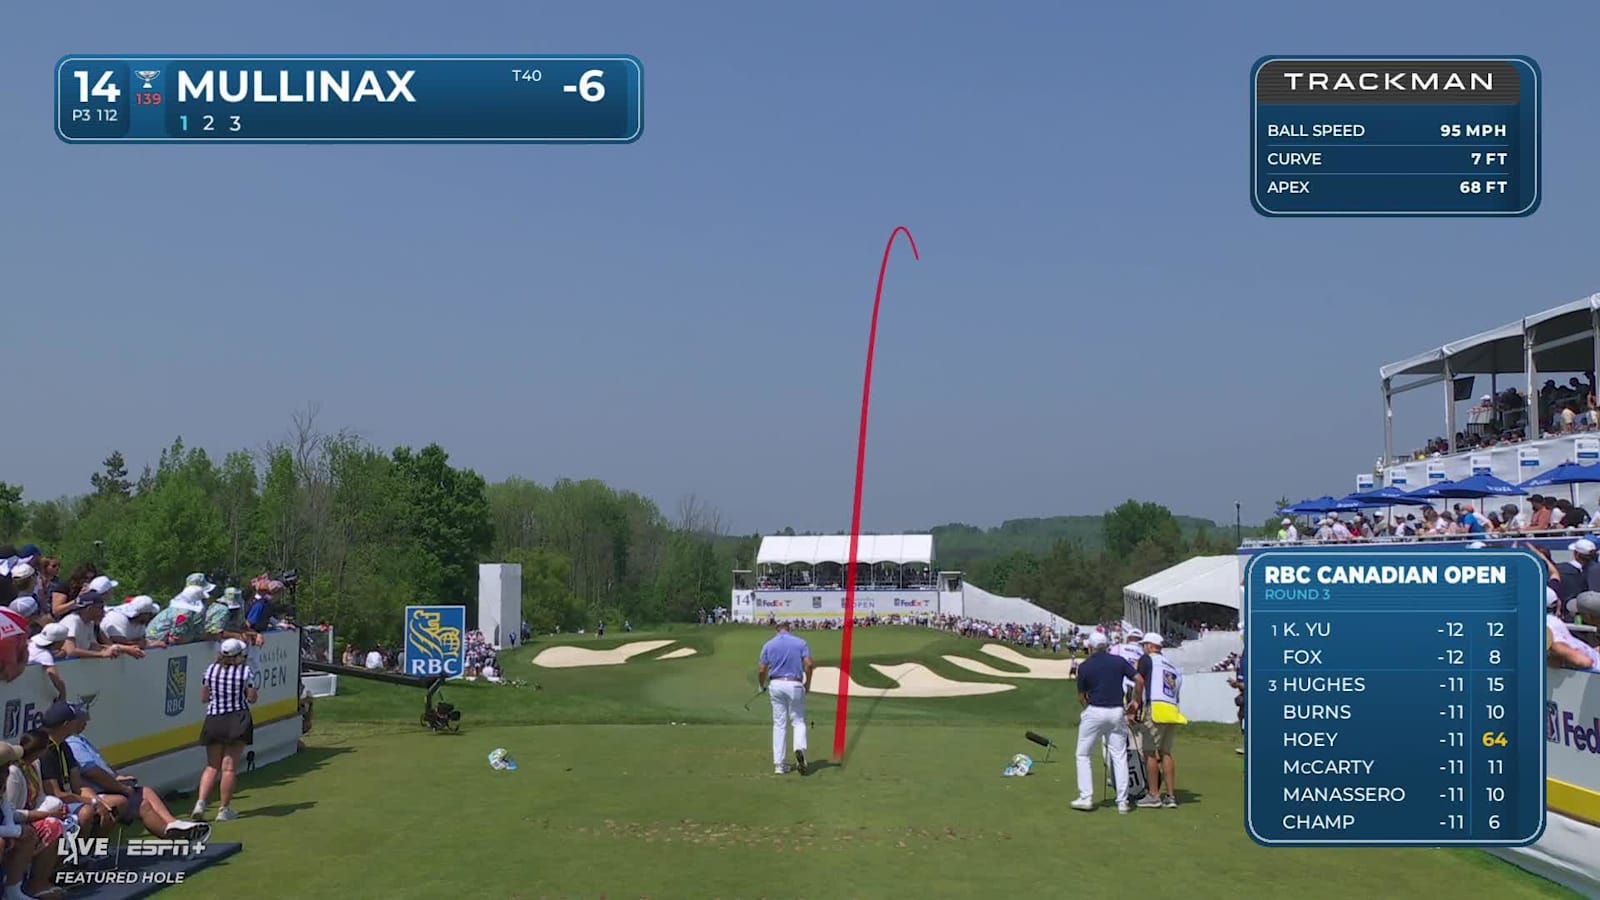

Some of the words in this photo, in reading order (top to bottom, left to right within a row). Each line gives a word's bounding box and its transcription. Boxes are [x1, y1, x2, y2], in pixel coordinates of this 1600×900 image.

[736, 594, 750, 606] 14
[411, 658, 457, 674] RBC
[167, 696, 184, 713] RBC
